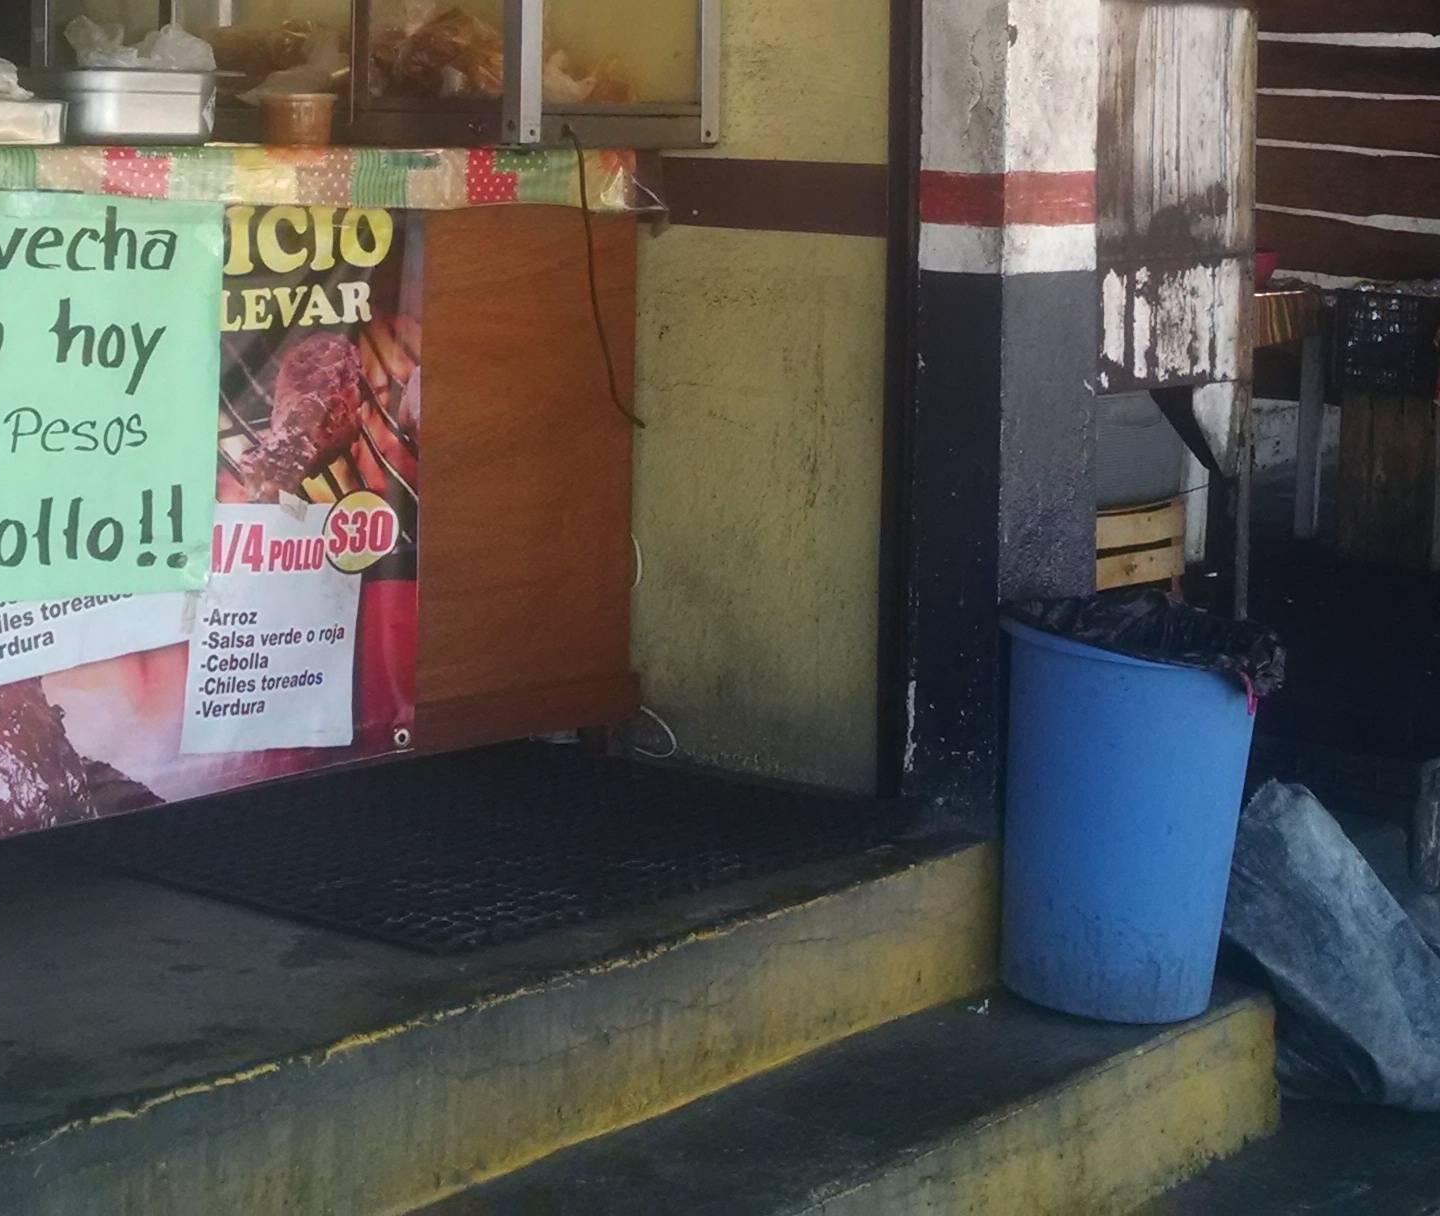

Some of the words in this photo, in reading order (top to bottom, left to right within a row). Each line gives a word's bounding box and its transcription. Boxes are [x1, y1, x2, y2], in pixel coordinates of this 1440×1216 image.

[223, 205, 394, 275] ICIO
[220, 282, 373, 332] LEVAR
[49, 298, 167, 396] hoy
[3, 406, 149, 456] Pesos
[268, 538, 325, 572] POLLO
[329, 509, 394, 558] $30
[201, 631, 255, 649] -Salsa
[260, 627, 302, 646] verde
[306, 630, 315, 642] o
[319, 623, 345, 645] roja
[203, 608, 258, 626] -Arroz
[200, 652, 269, 672] -Cebolla
[198, 676, 256, 695] -Chiles
[261, 669, 323, 691] toreados
[195, 698, 266, 718] -Verdura
